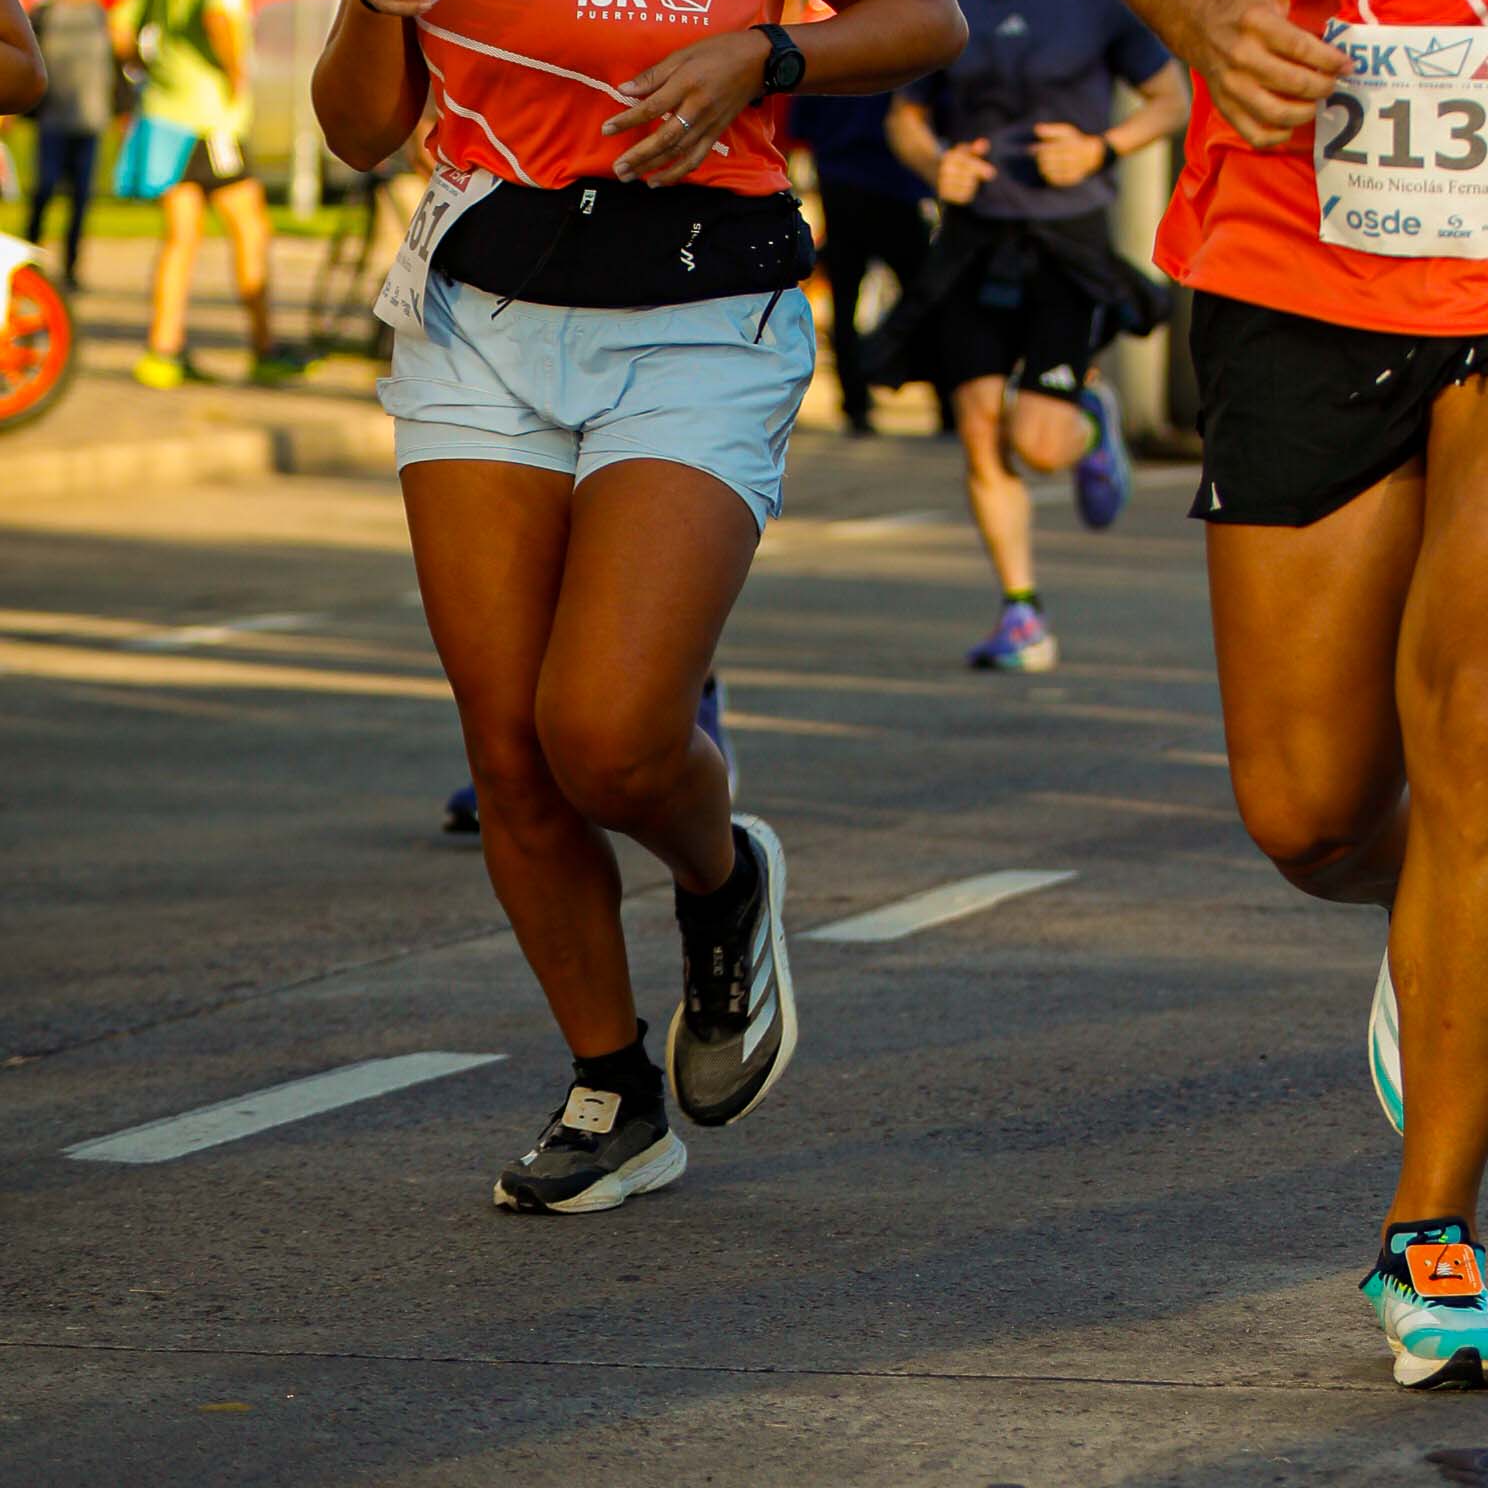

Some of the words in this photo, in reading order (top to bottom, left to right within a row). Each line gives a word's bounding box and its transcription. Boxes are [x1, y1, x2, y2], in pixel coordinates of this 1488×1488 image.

[576, 11, 647, 22] PUERTO
[655, 13, 710, 26] NORTE
[1348, 172, 1384, 190] Miño
[1388, 176, 1444, 194] Nicolás
[1346, 209, 1422, 238] osde
